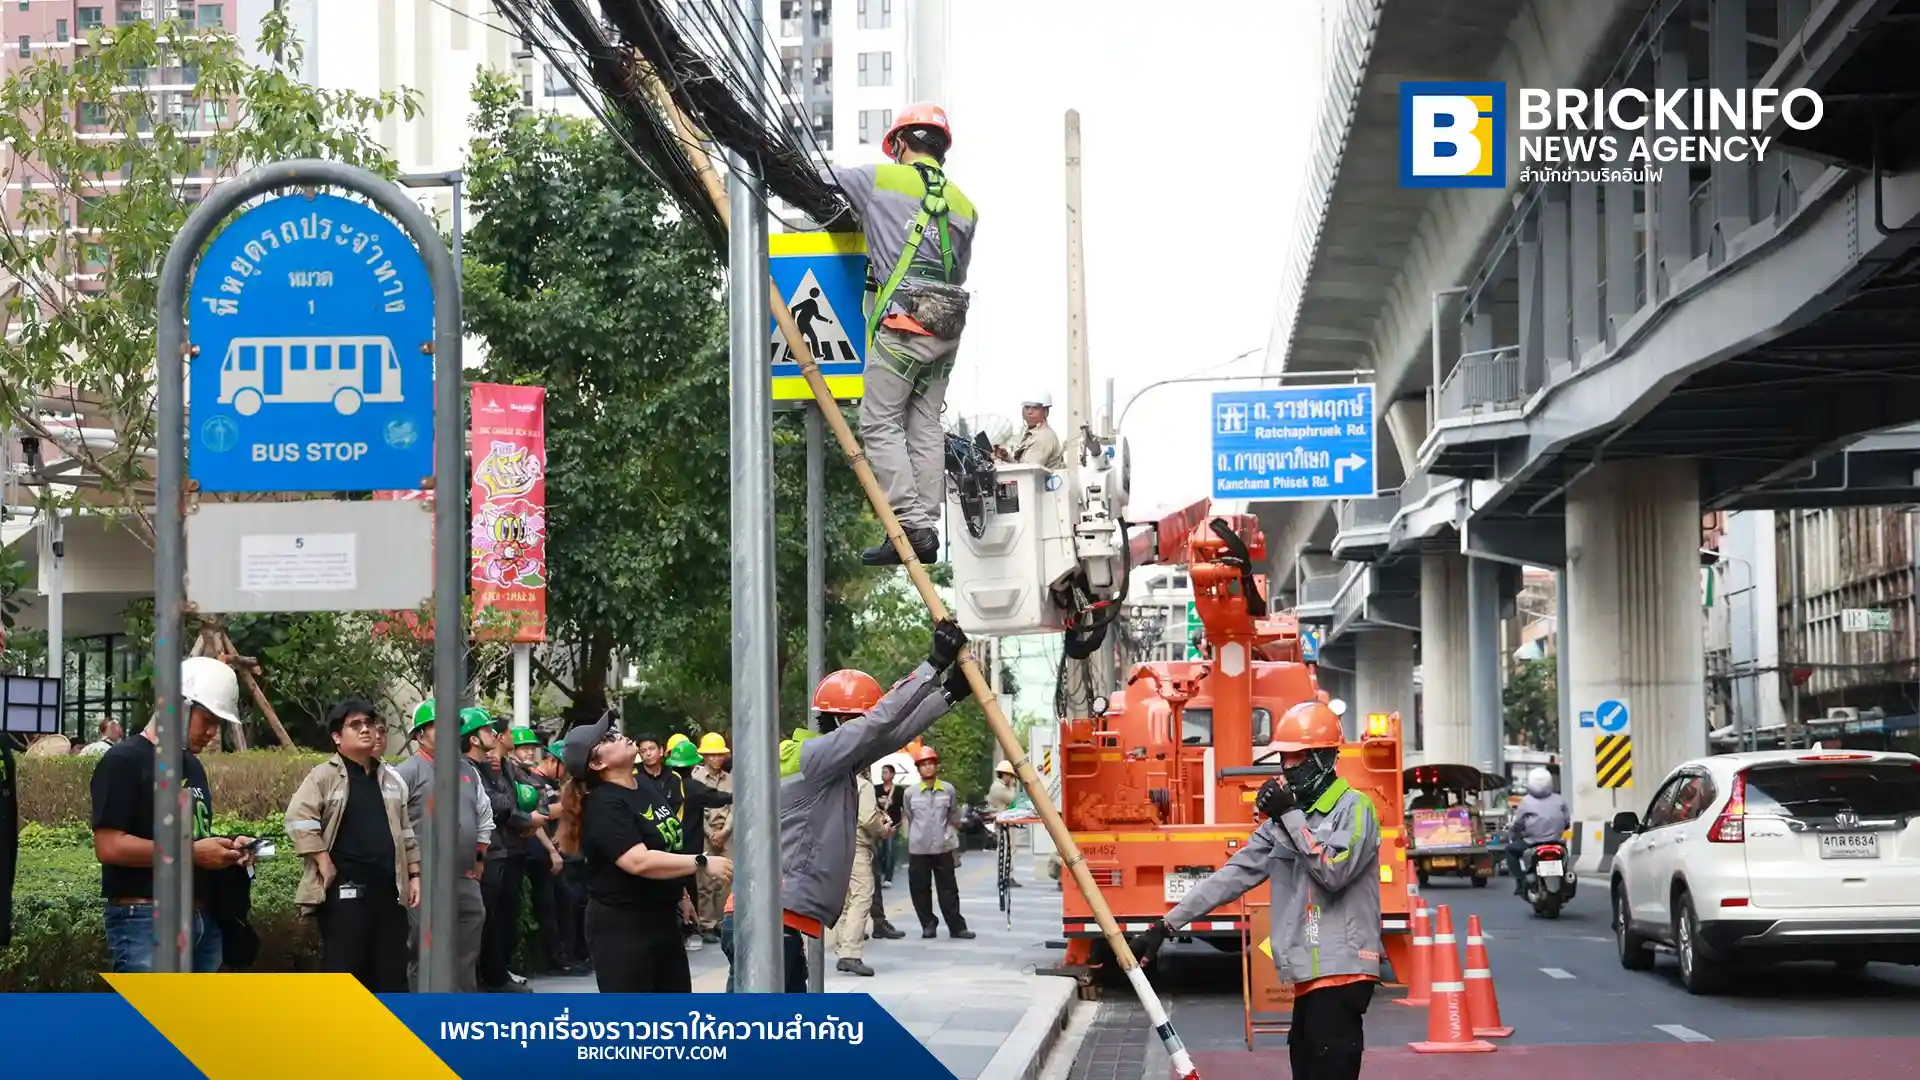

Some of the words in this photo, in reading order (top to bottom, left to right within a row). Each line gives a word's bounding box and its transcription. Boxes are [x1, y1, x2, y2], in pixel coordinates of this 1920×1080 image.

[288, 271, 333, 287] หมวด
[308, 300, 314, 314] 1
[1254, 402, 1271, 420] ถ.
[1274, 392, 1366, 420] ราชพฤกษ์
[1255, 425, 1341, 439] Ratchaphruek
[1347, 423, 1366, 436] Rd.
[252, 444, 300, 462] BUS
[306, 442, 368, 461] STOP
[1218, 453, 1231, 472] ถ.
[1234, 446, 1329, 474] กาญจนาภิเษก
[1217, 478, 1270, 491] Kanchana
[1273, 476, 1309, 489] Phisek
[1312, 475, 1330, 487] Rd.
[296, 538, 304, 549] 5
[654, 805, 670, 820] AIS
[1848, 835, 1875, 847] 6634
